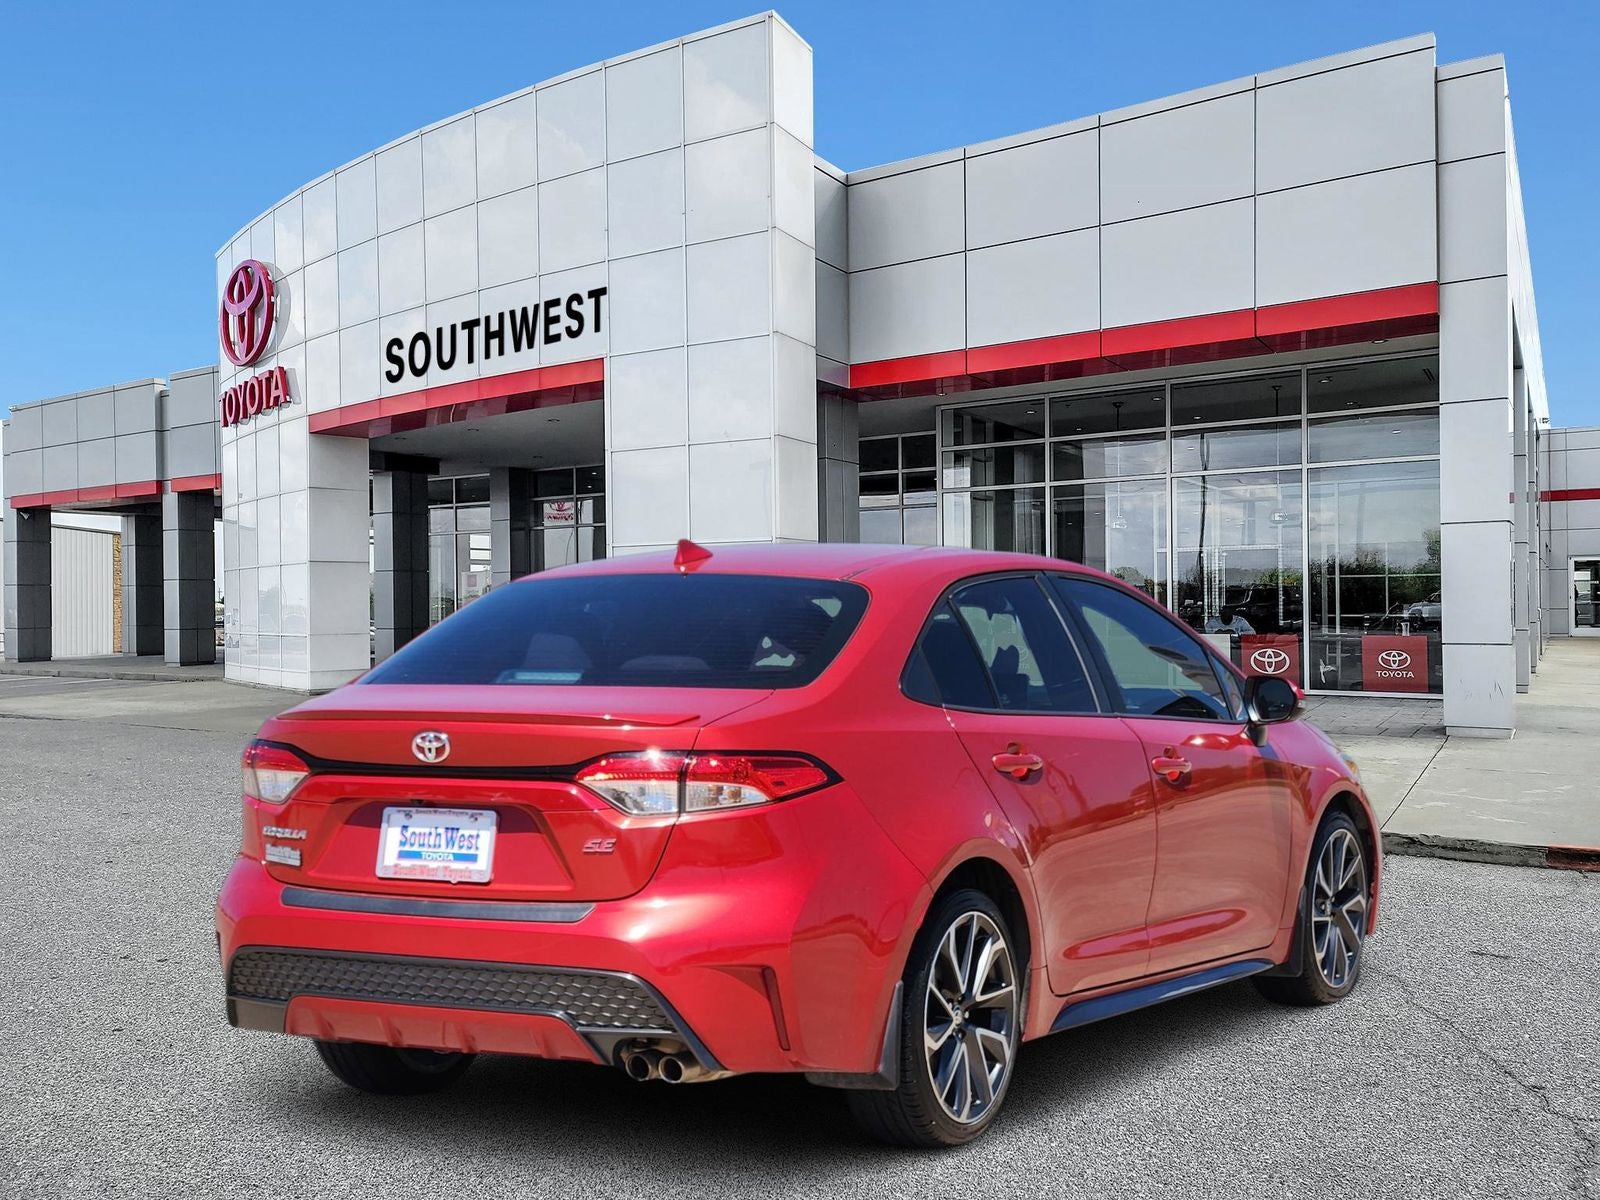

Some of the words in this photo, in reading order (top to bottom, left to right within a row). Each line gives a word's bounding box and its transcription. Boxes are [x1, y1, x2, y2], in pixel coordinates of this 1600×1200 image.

[385, 286, 608, 383] SOUTHWEST
[218, 366, 288, 427] TOYOTA
[1375, 670, 1415, 678] TOYOTA
[582, 838, 617, 853] SE
[421, 852, 454, 861] TOYOTA
